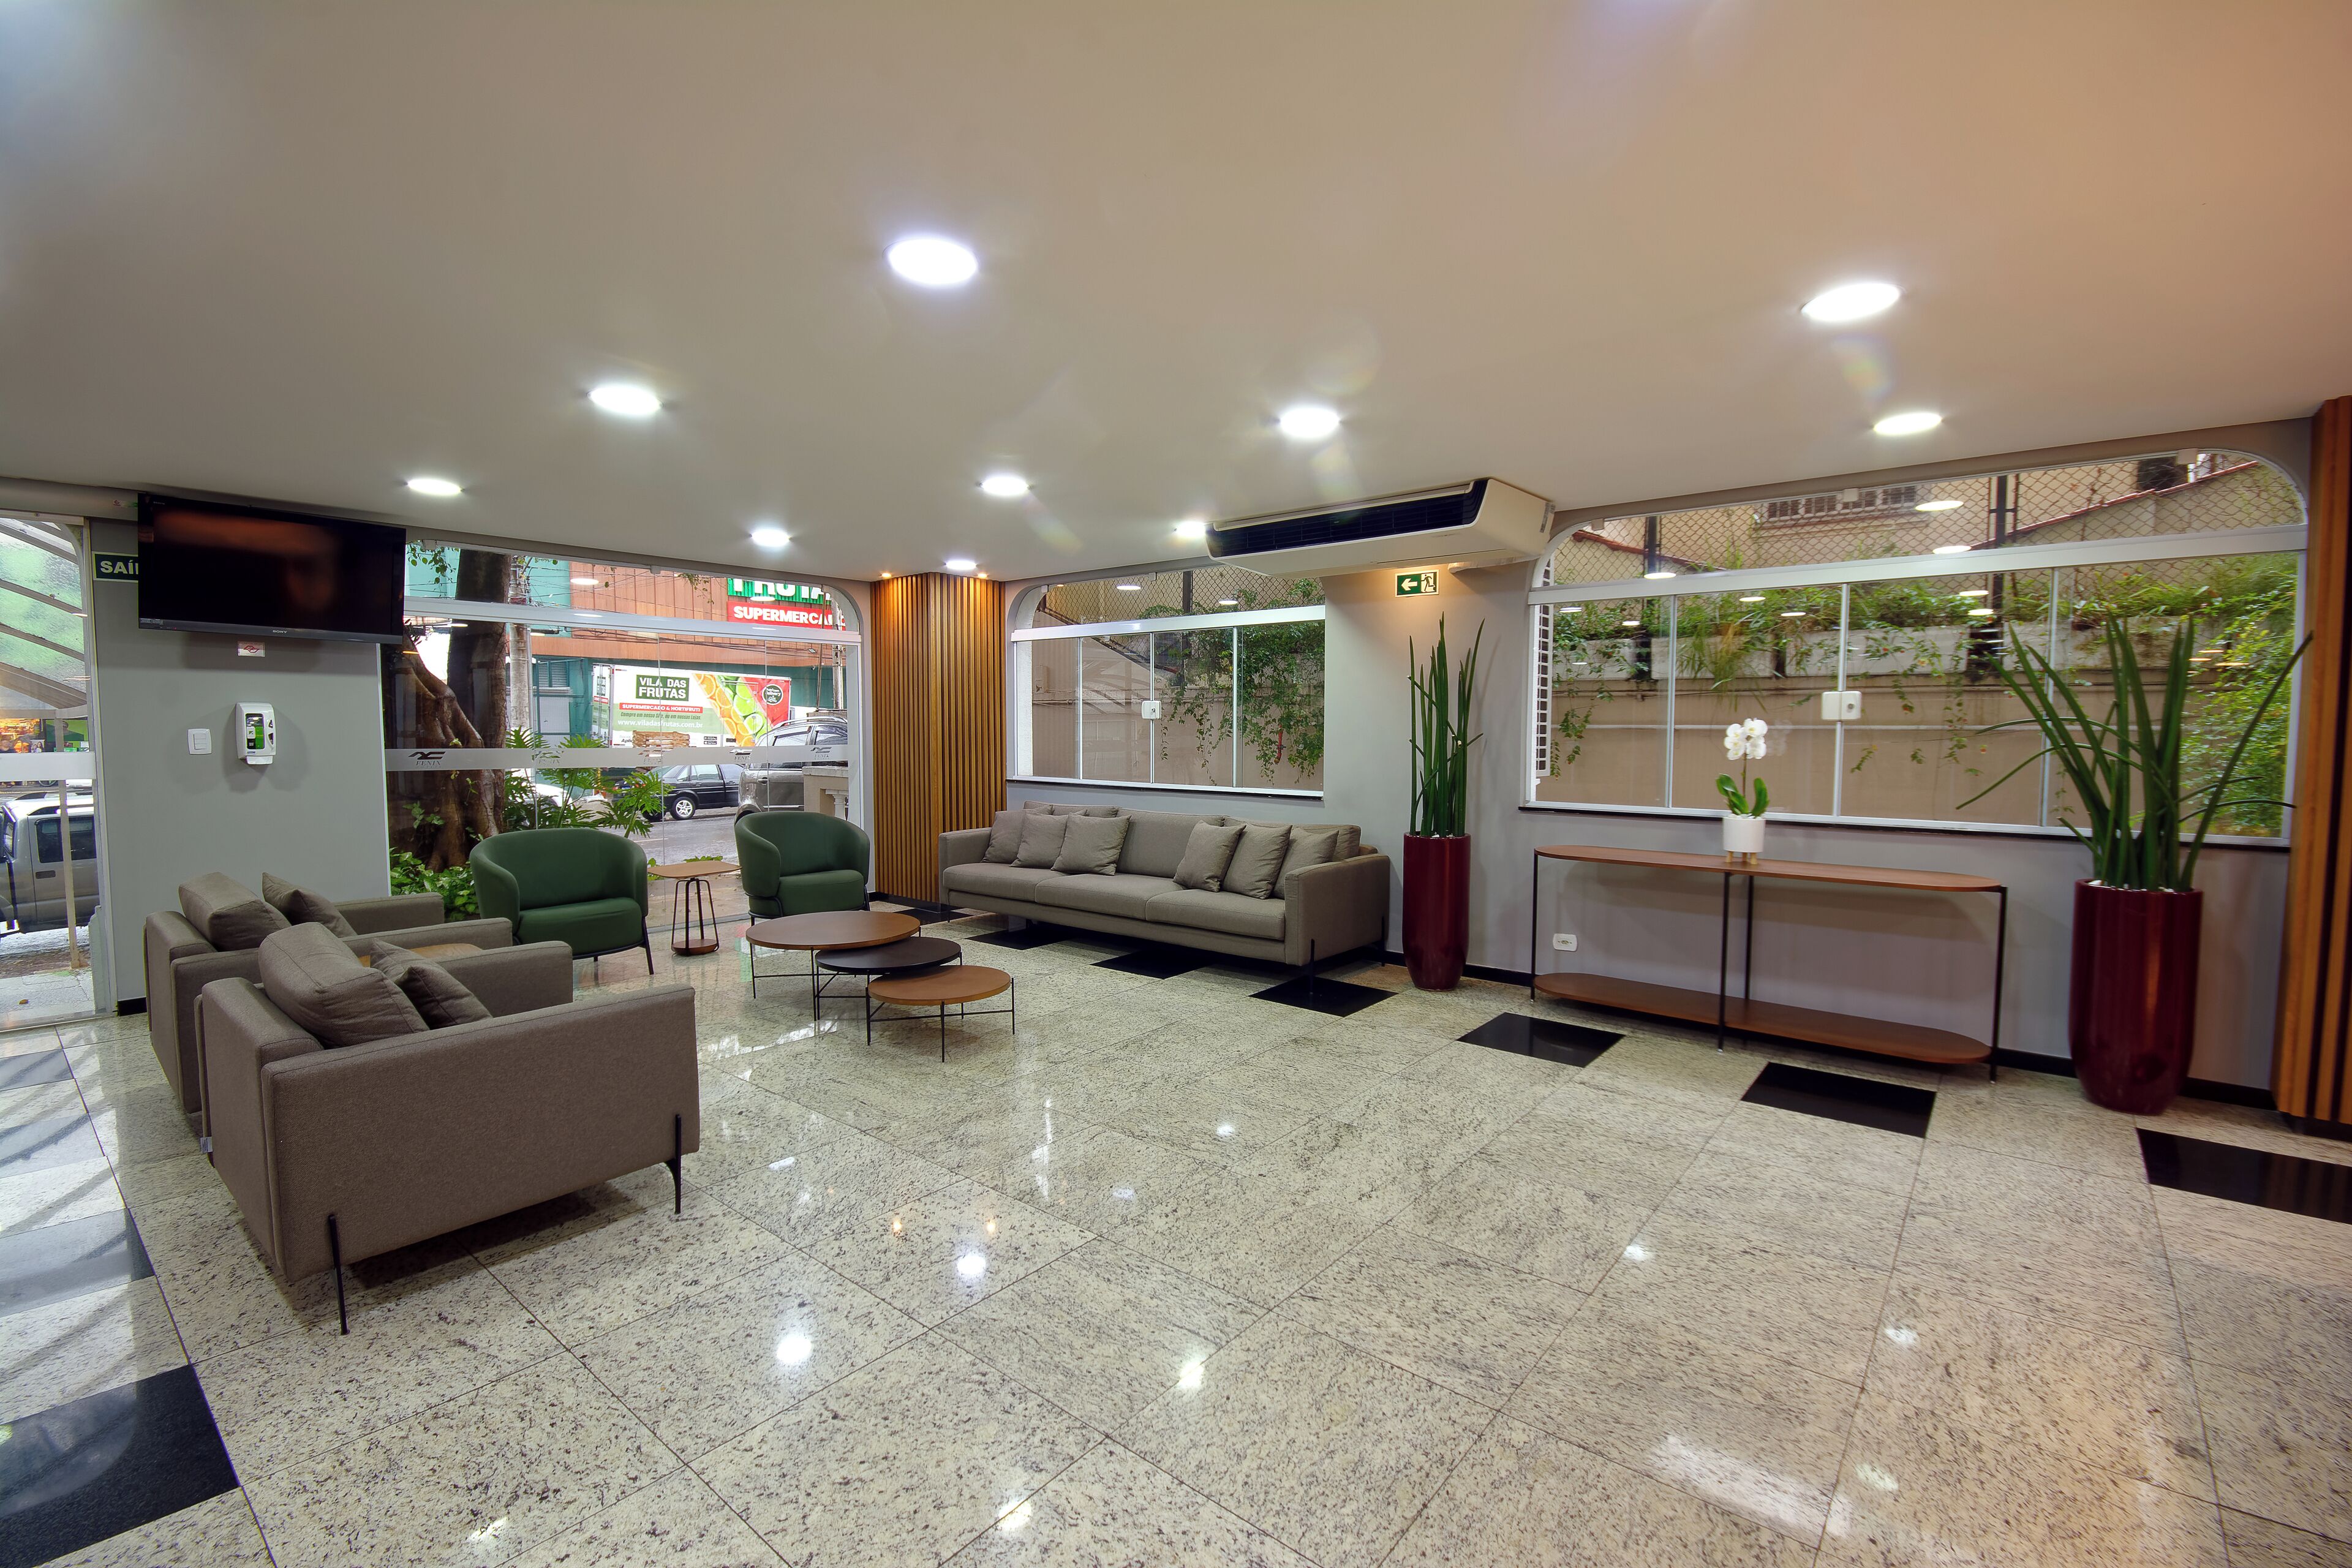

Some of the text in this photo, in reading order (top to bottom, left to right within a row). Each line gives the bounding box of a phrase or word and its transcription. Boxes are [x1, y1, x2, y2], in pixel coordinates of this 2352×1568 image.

[100, 560, 138, 575] SAÍ
[639, 677, 687, 688] VILA DAS
[638, 687, 686, 699] FRUTAS
[617, 719, 703, 728] www.viladasfrutas.com.br
